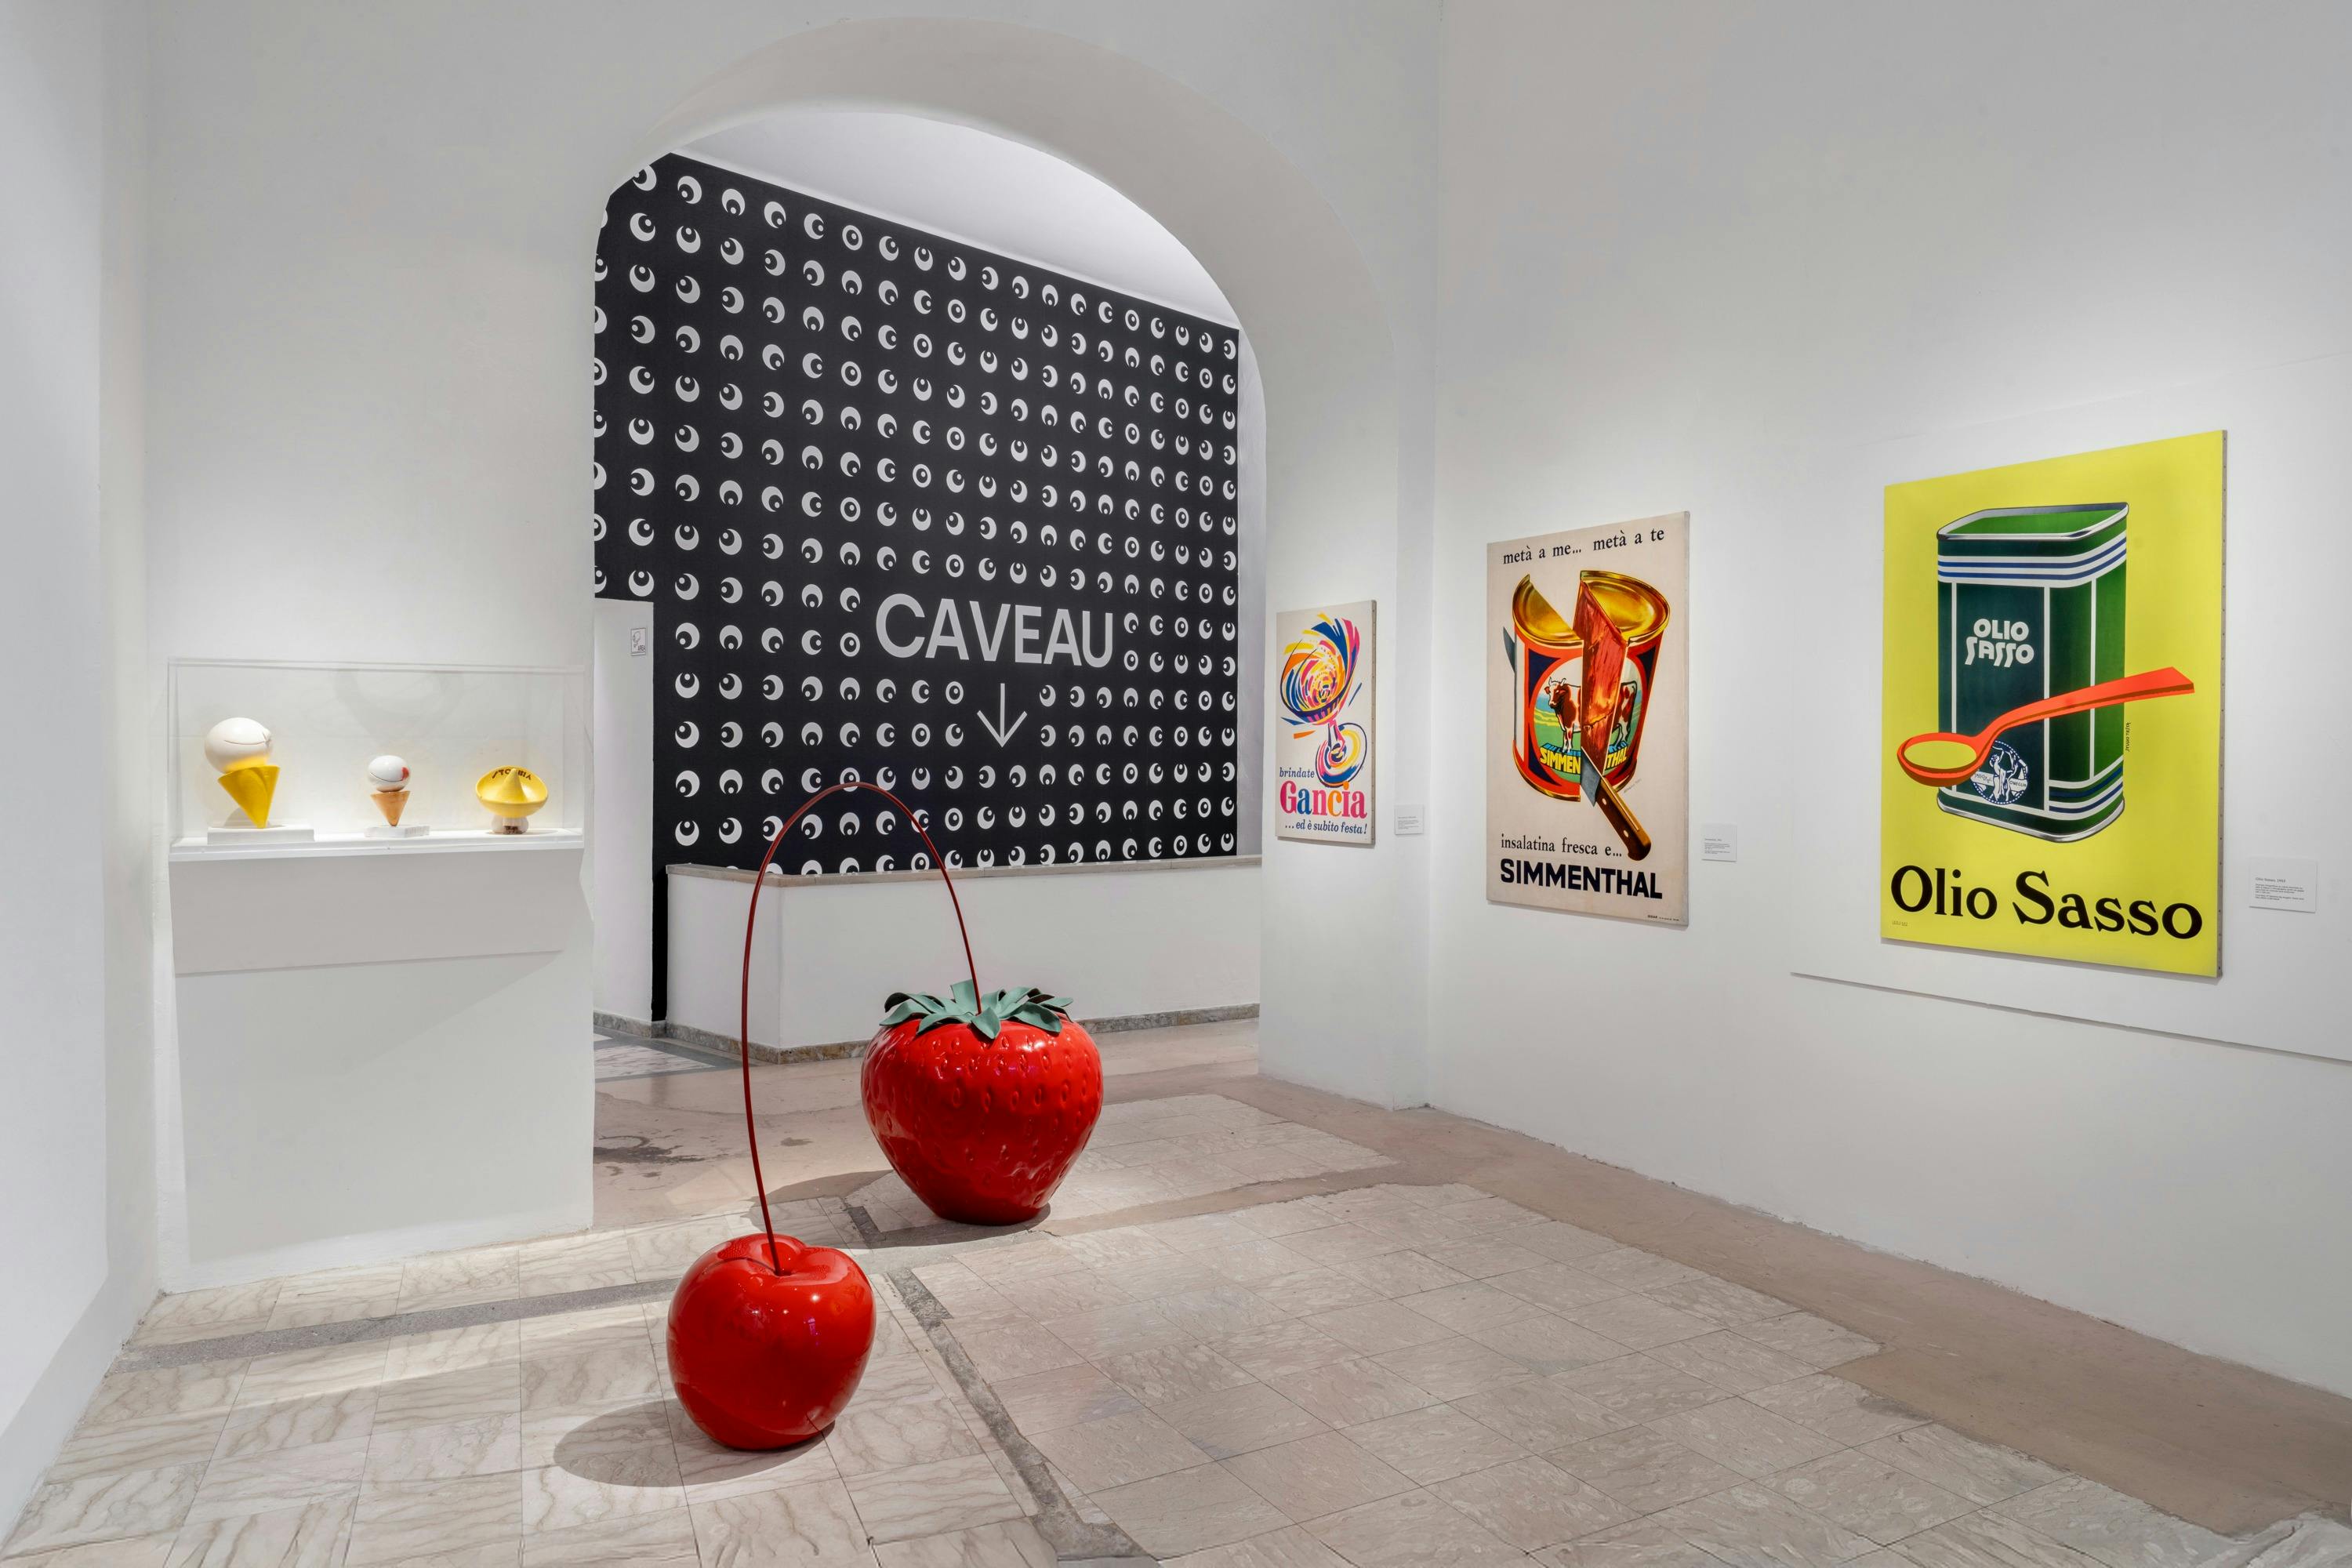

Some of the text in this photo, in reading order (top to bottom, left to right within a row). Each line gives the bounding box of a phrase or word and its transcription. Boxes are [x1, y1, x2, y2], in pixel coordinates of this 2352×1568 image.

[1503, 546, 1532, 564] metà
[1538, 549, 1546, 559] a
[1593, 530, 1627, 551] metà
[1635, 532, 1642, 544] a
[1650, 528, 1664, 542] te
[876, 593, 1113, 668] CAVEAU
[1973, 618, 2029, 641] OLIO
[1965, 636, 2034, 668] SASSO
[1279, 767, 1315, 779] brindate
[1279, 780, 1367, 819] Gancia
[1307, 820, 1312, 829] è
[1313, 820, 1339, 832] subito
[1501, 833, 1622, 857] insalatina fresca e...
[1500, 858, 1663, 899] SIMMENTHAL
[1891, 865, 2203, 939] Olio Sasso
